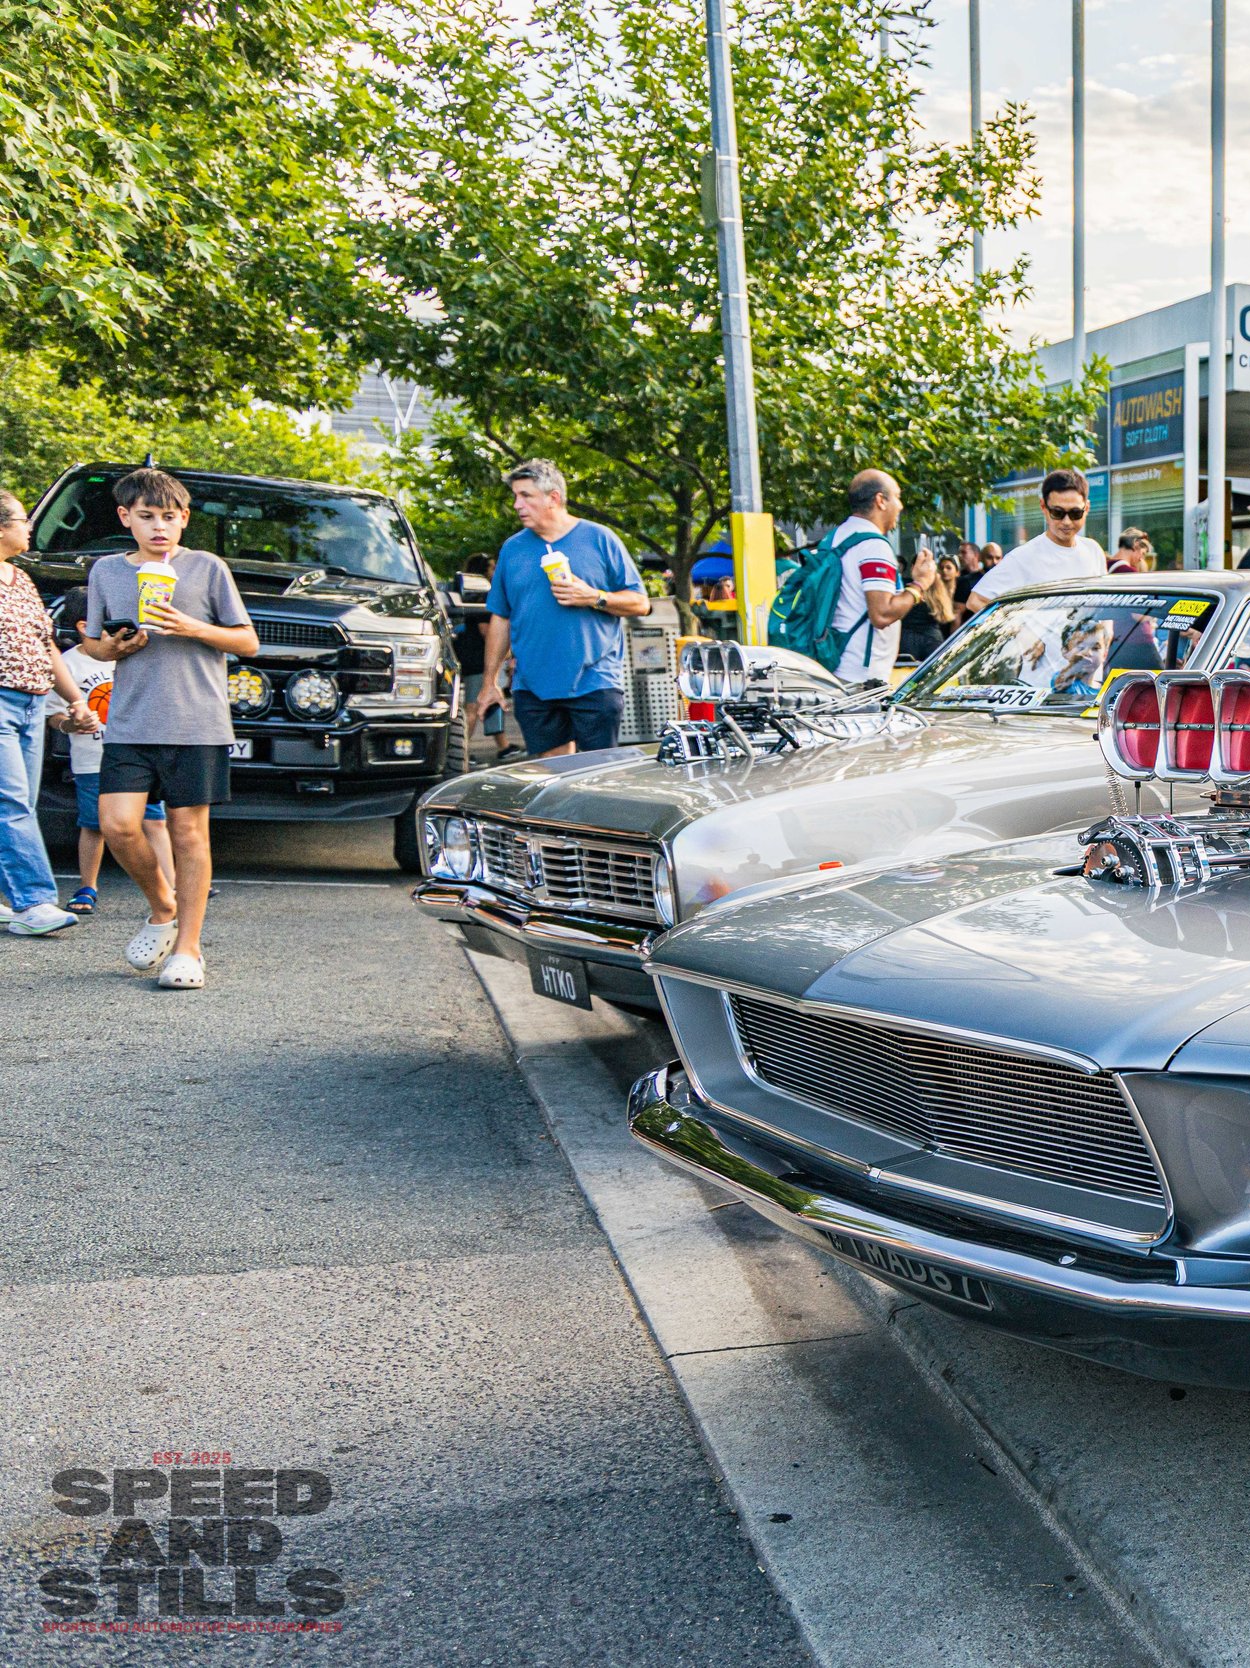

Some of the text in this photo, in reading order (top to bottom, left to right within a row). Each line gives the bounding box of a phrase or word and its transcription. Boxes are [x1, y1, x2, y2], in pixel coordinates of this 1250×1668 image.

[1113, 385, 1183, 428] AUTOWASH
[1125, 424, 1168, 447] SOFT CLOTH
[79, 669, 115, 694] ATHL
[988, 688, 1036, 706] 0676
[541, 964, 576, 1001] HTKO
